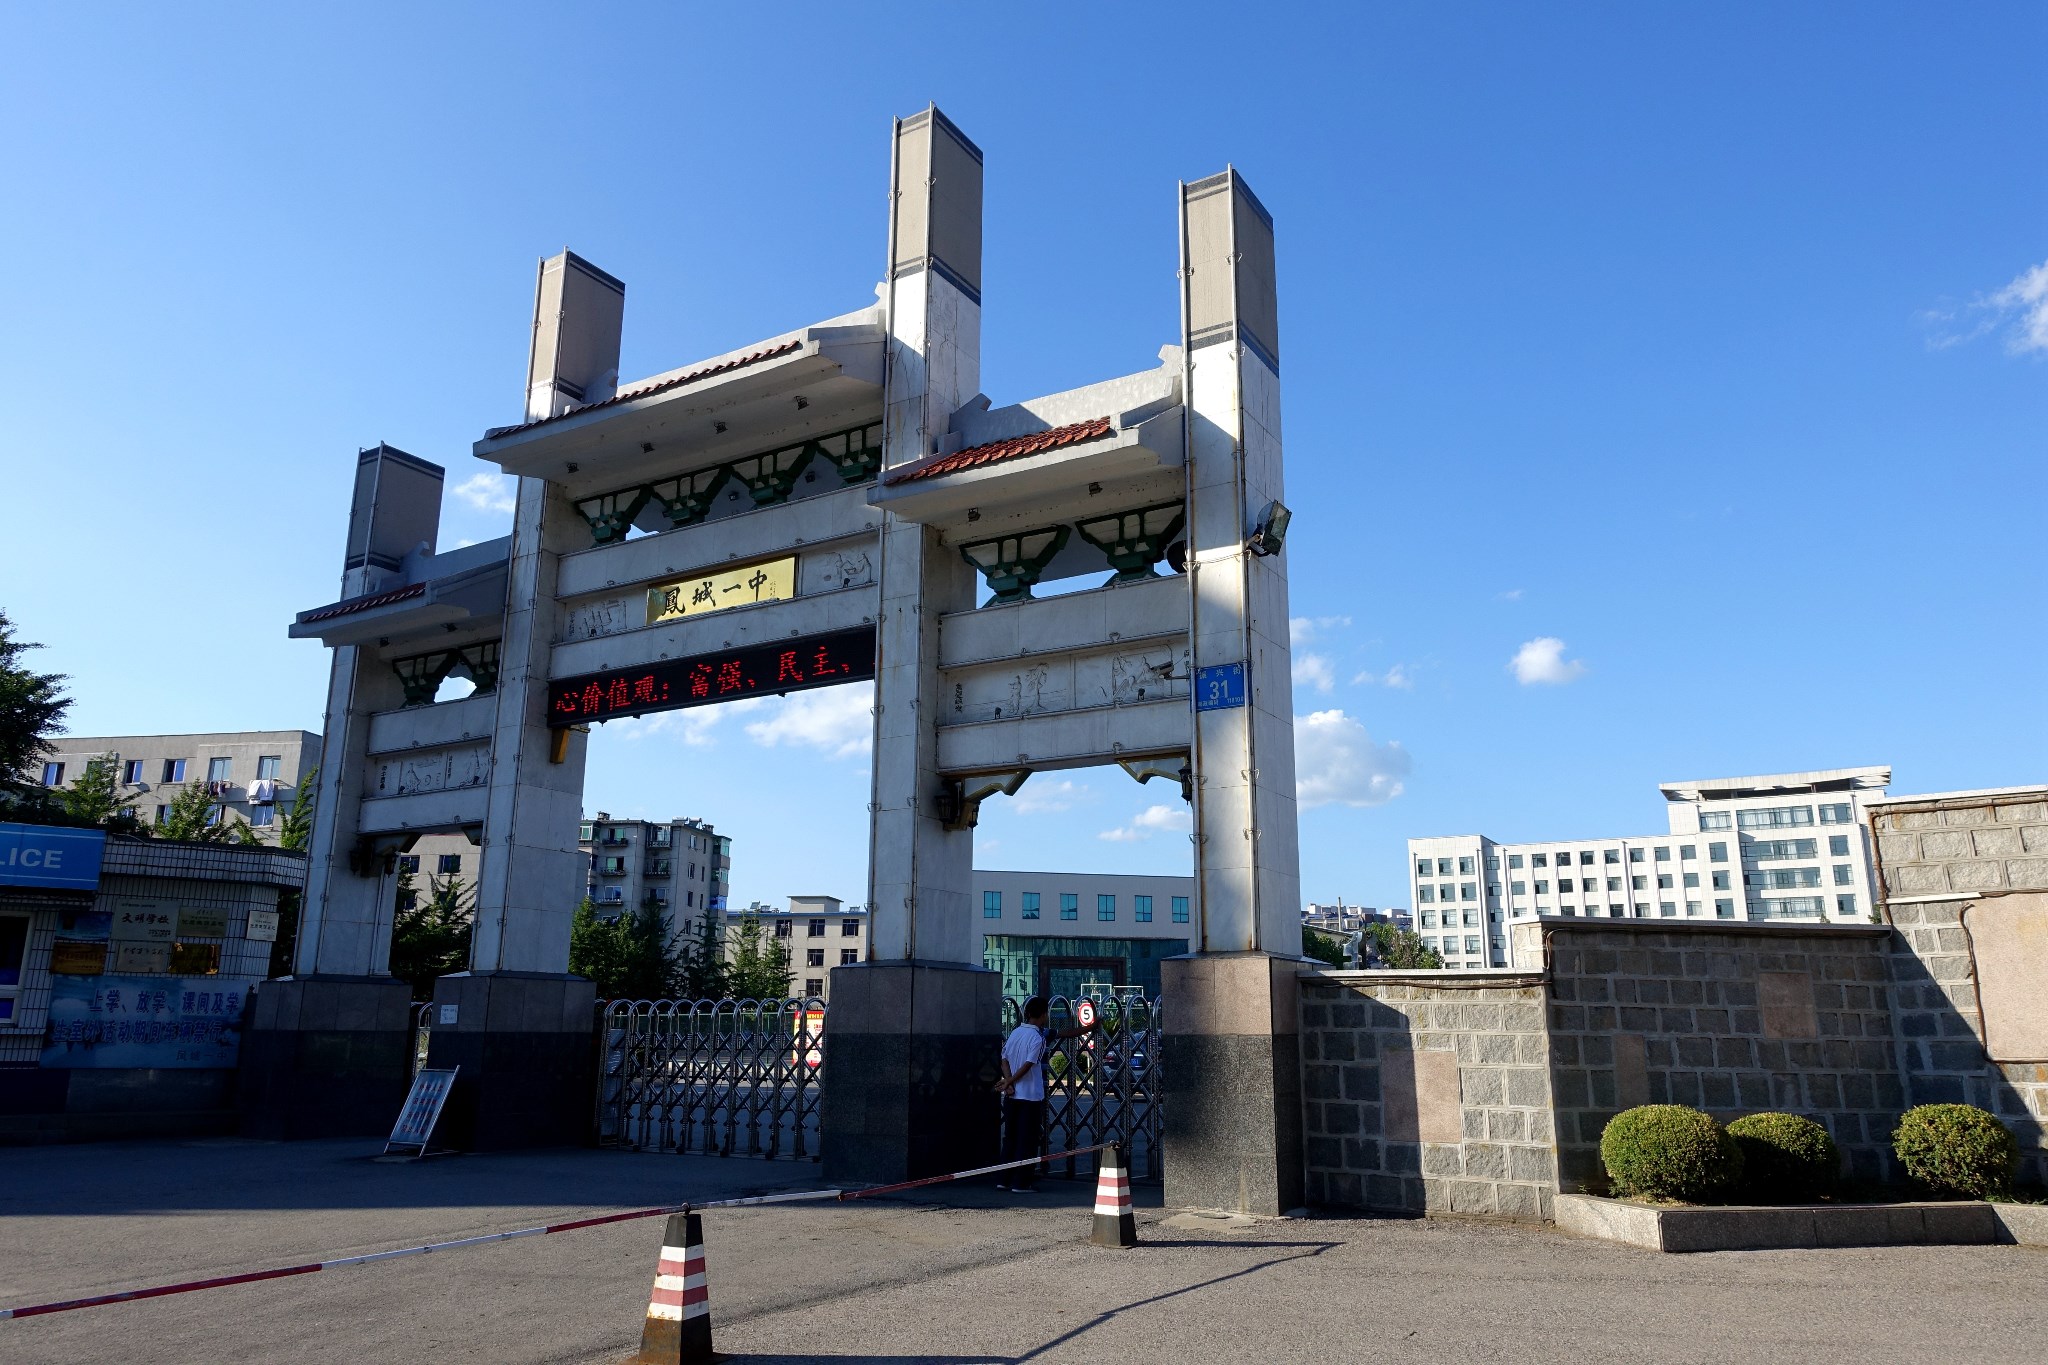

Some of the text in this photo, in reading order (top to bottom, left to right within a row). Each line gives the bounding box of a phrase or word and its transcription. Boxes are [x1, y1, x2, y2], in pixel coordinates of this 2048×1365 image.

[1209, 680, 1229, 700] 31
[0, 848, 64, 869] ICE
[1084, 1009, 1090, 1020] 5
